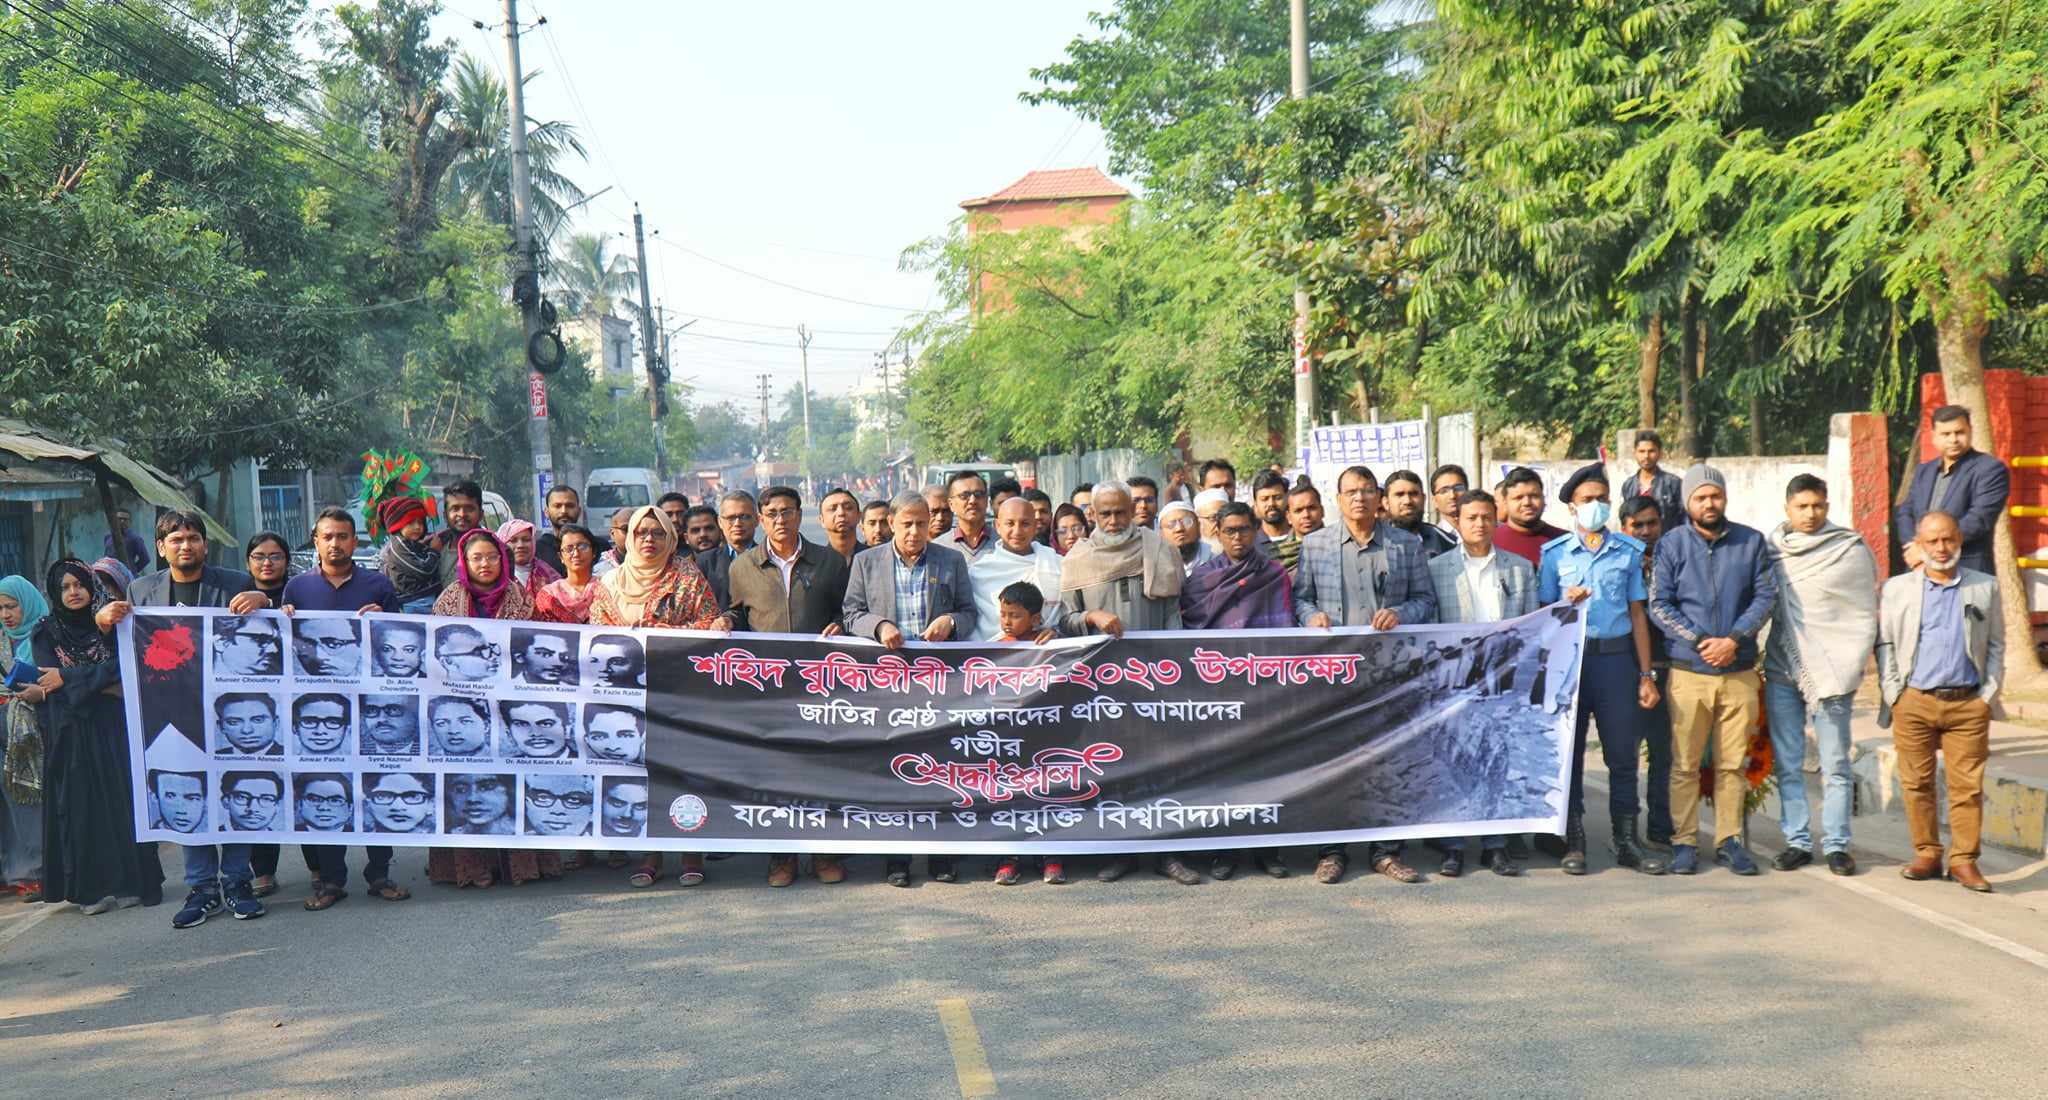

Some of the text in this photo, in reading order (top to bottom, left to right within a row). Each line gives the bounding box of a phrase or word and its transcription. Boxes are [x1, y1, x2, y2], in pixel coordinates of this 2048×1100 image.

[688, 647, 1364, 697] শহিদ বুদ্ধিজীবী দিবস-২০২৩ উপলক্ষ্যে
[797, 695, 1246, 728] জাতির শ্রেষ্ঠ সন্তানদের প্রতি আমাদের
[950, 730, 1025, 758] গভীর
[890, 743, 1123, 808] শ্রদ্ধাঞ্জলি
[730, 803, 829, 829] যশোর
[841, 804, 940, 831] বিজ্ঞান
[954, 809, 978, 828] ও
[991, 803, 1086, 835] প্রযুক্তি
[1097, 798, 1285, 831] বিশ্ববিদ্যালয়
